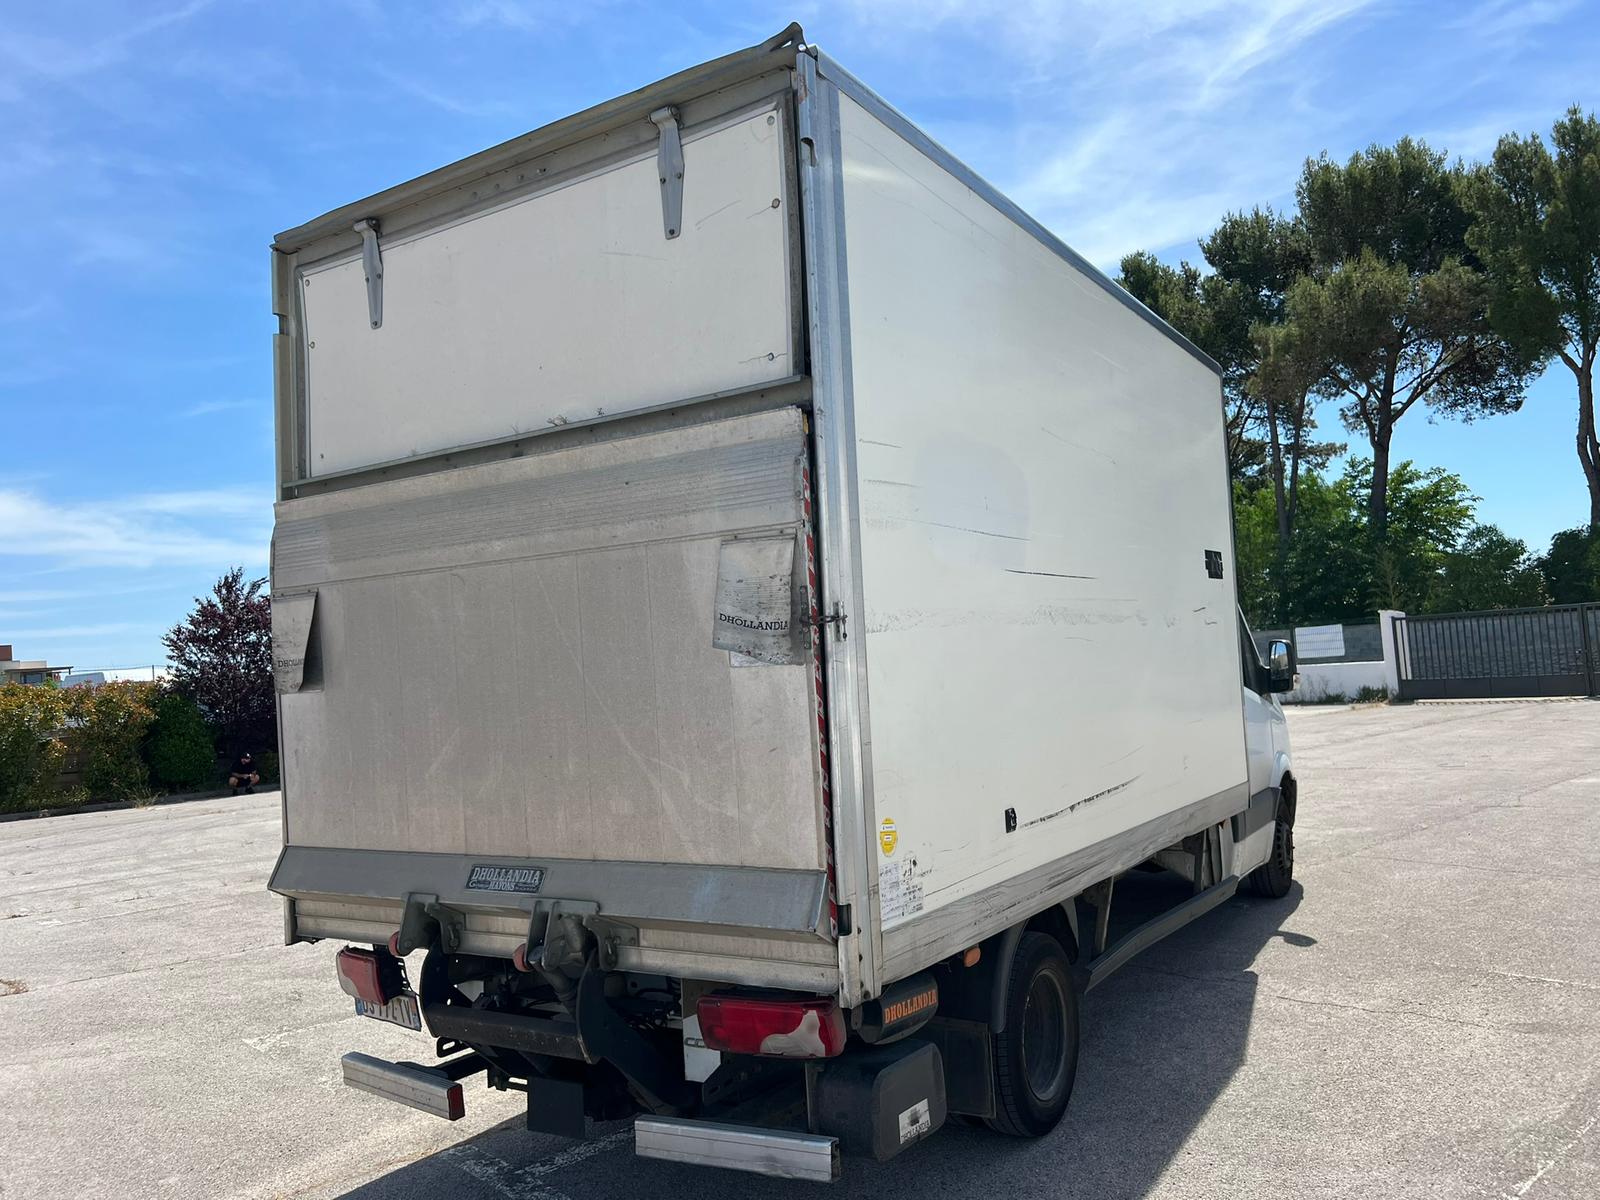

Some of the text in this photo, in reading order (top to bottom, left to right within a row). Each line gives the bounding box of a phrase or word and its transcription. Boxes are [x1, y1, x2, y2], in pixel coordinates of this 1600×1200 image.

[719, 613, 789, 631] DHOLLANDIA
[471, 867, 541, 885] DHOLLANDIA
[488, 880, 516, 891] HAYONS
[884, 989, 937, 1024] DHOLLANDIA
